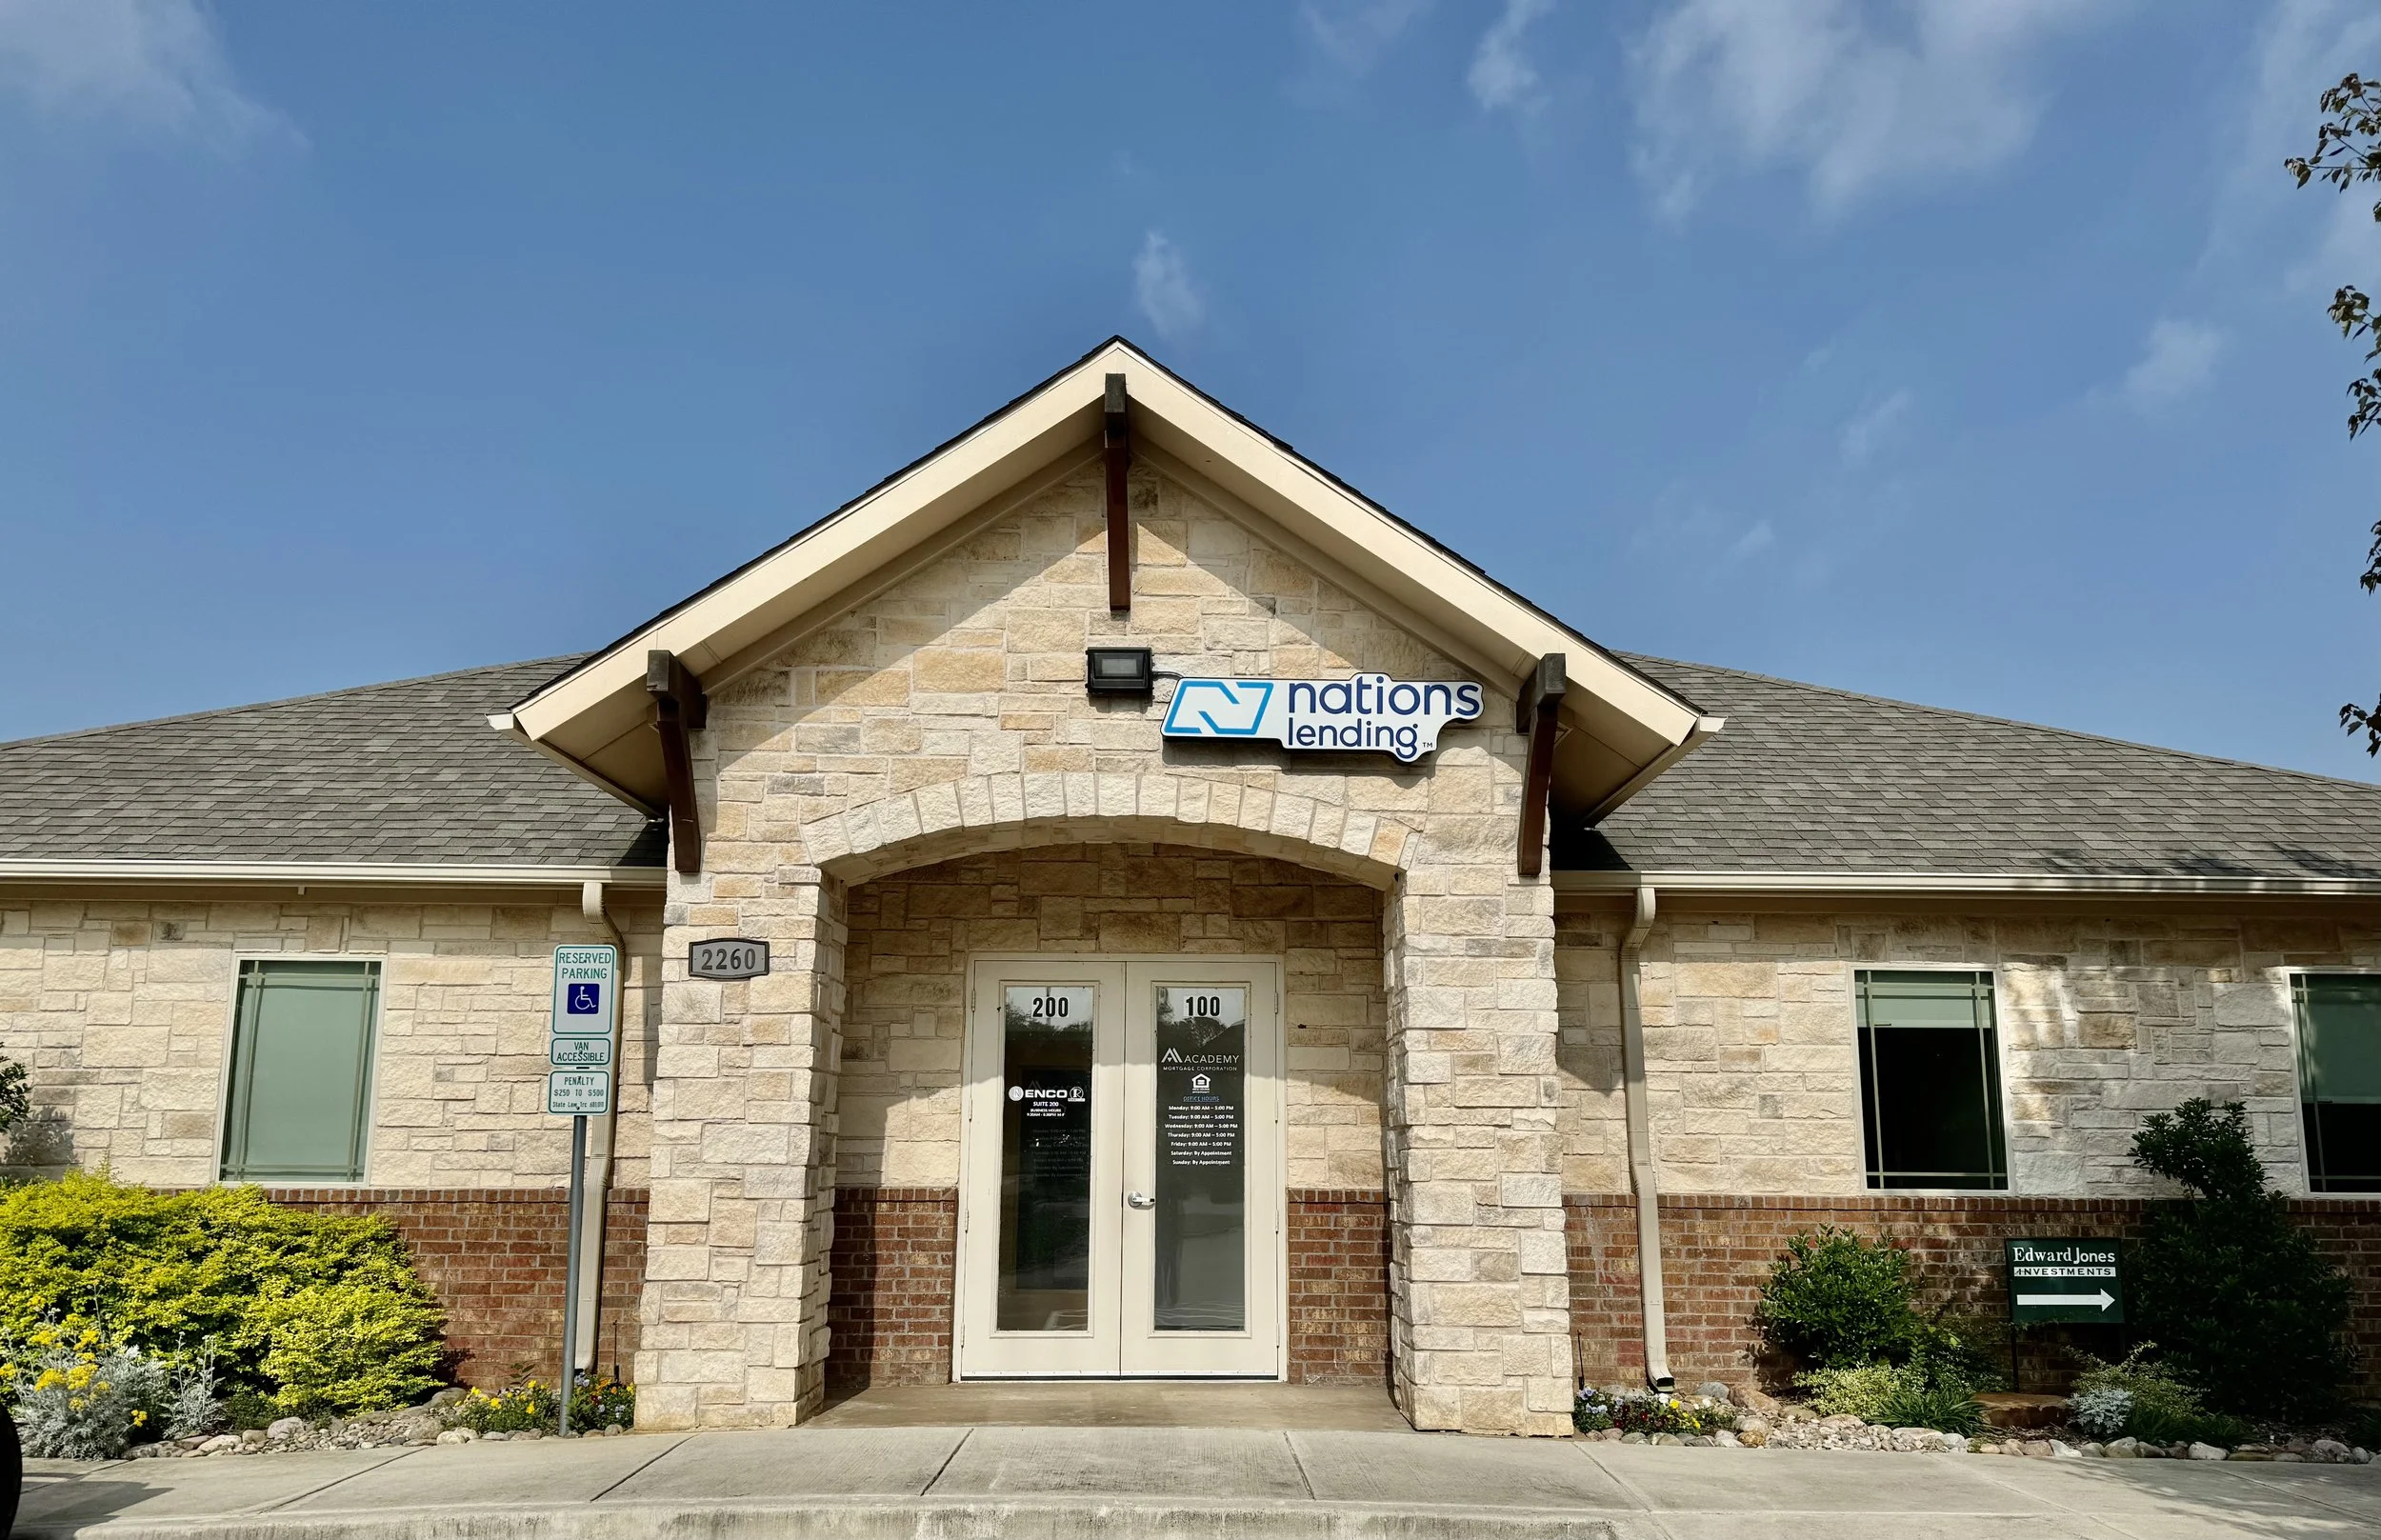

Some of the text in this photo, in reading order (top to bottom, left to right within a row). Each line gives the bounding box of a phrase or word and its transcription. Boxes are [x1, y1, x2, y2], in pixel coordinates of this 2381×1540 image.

[1289, 676, 1480, 716] nations
[1289, 717, 1418, 759] lending
[559, 953, 611, 963] RESERVED
[701, 948, 756, 970] 2260
[562, 968, 607, 979] PARKING
[1033, 997, 1068, 1017] 200
[1186, 996, 1220, 1016] 100
[574, 1042, 589, 1050] VAN
[557, 1052, 604, 1061] ACCESSIBLE
[1184, 1055, 1239, 1063] ACADEMY
[565, 1076, 594, 1085] PENALTY
[1025, 1089, 1067, 1098] ENCO
[2013, 1247, 2115, 1264] Edward Jones
